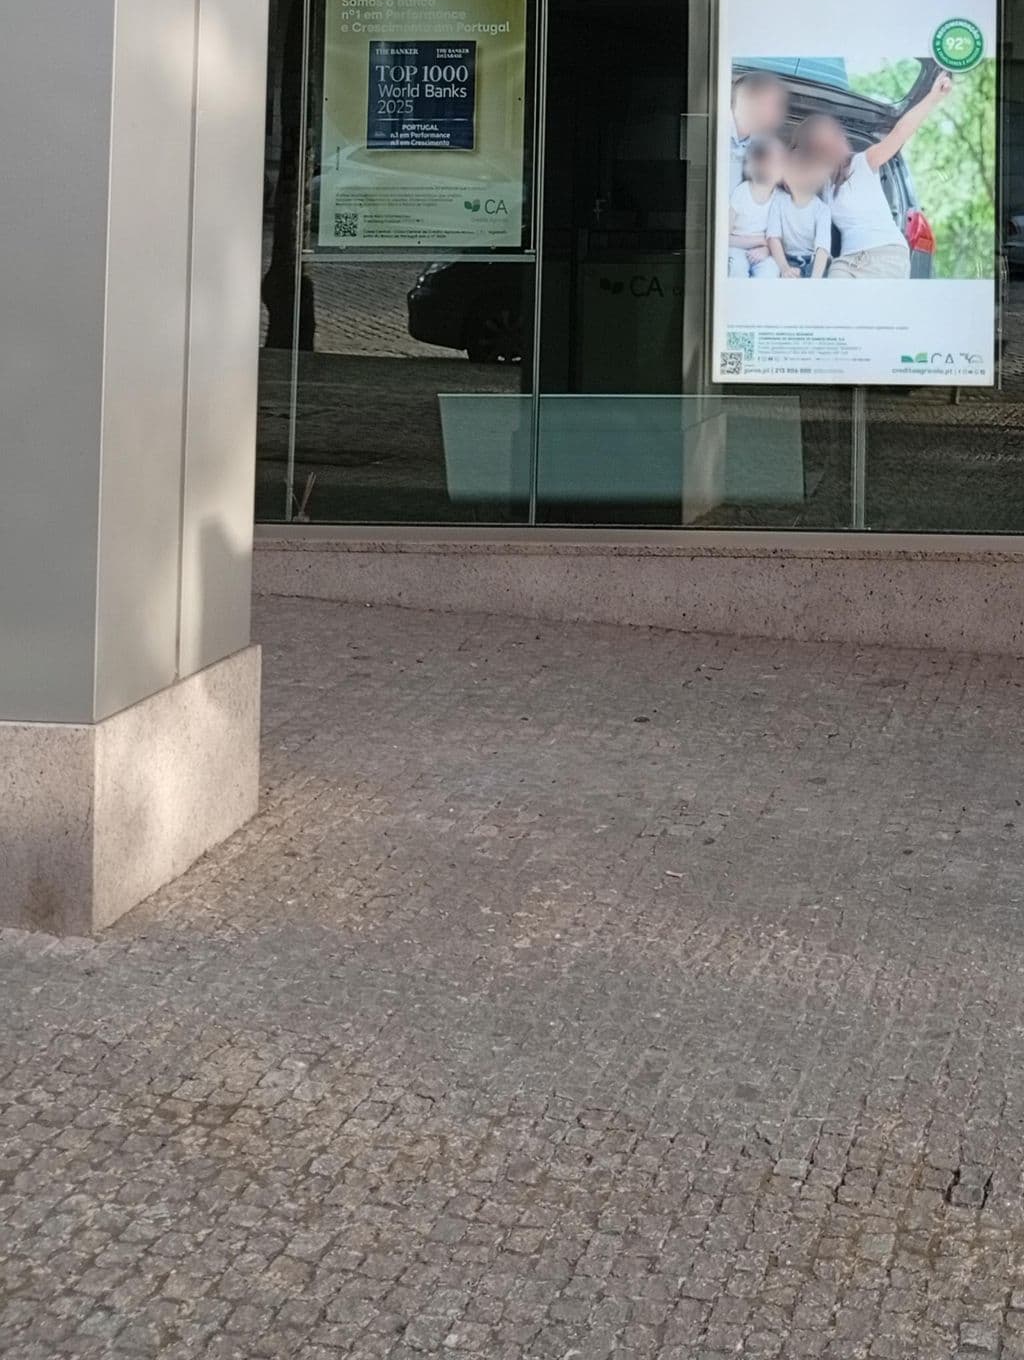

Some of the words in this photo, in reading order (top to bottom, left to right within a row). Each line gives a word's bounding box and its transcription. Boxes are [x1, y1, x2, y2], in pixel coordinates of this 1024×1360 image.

[457, 21, 510, 35] Portugal
[375, 65, 418, 82] TOP
[422, 65, 469, 82] 1000
[378, 83, 420, 98] World
[425, 83, 467, 98] Banks
[377, 100, 414, 114] 2025
[484, 199, 508, 214] CA
[630, 275, 664, 297] CA
